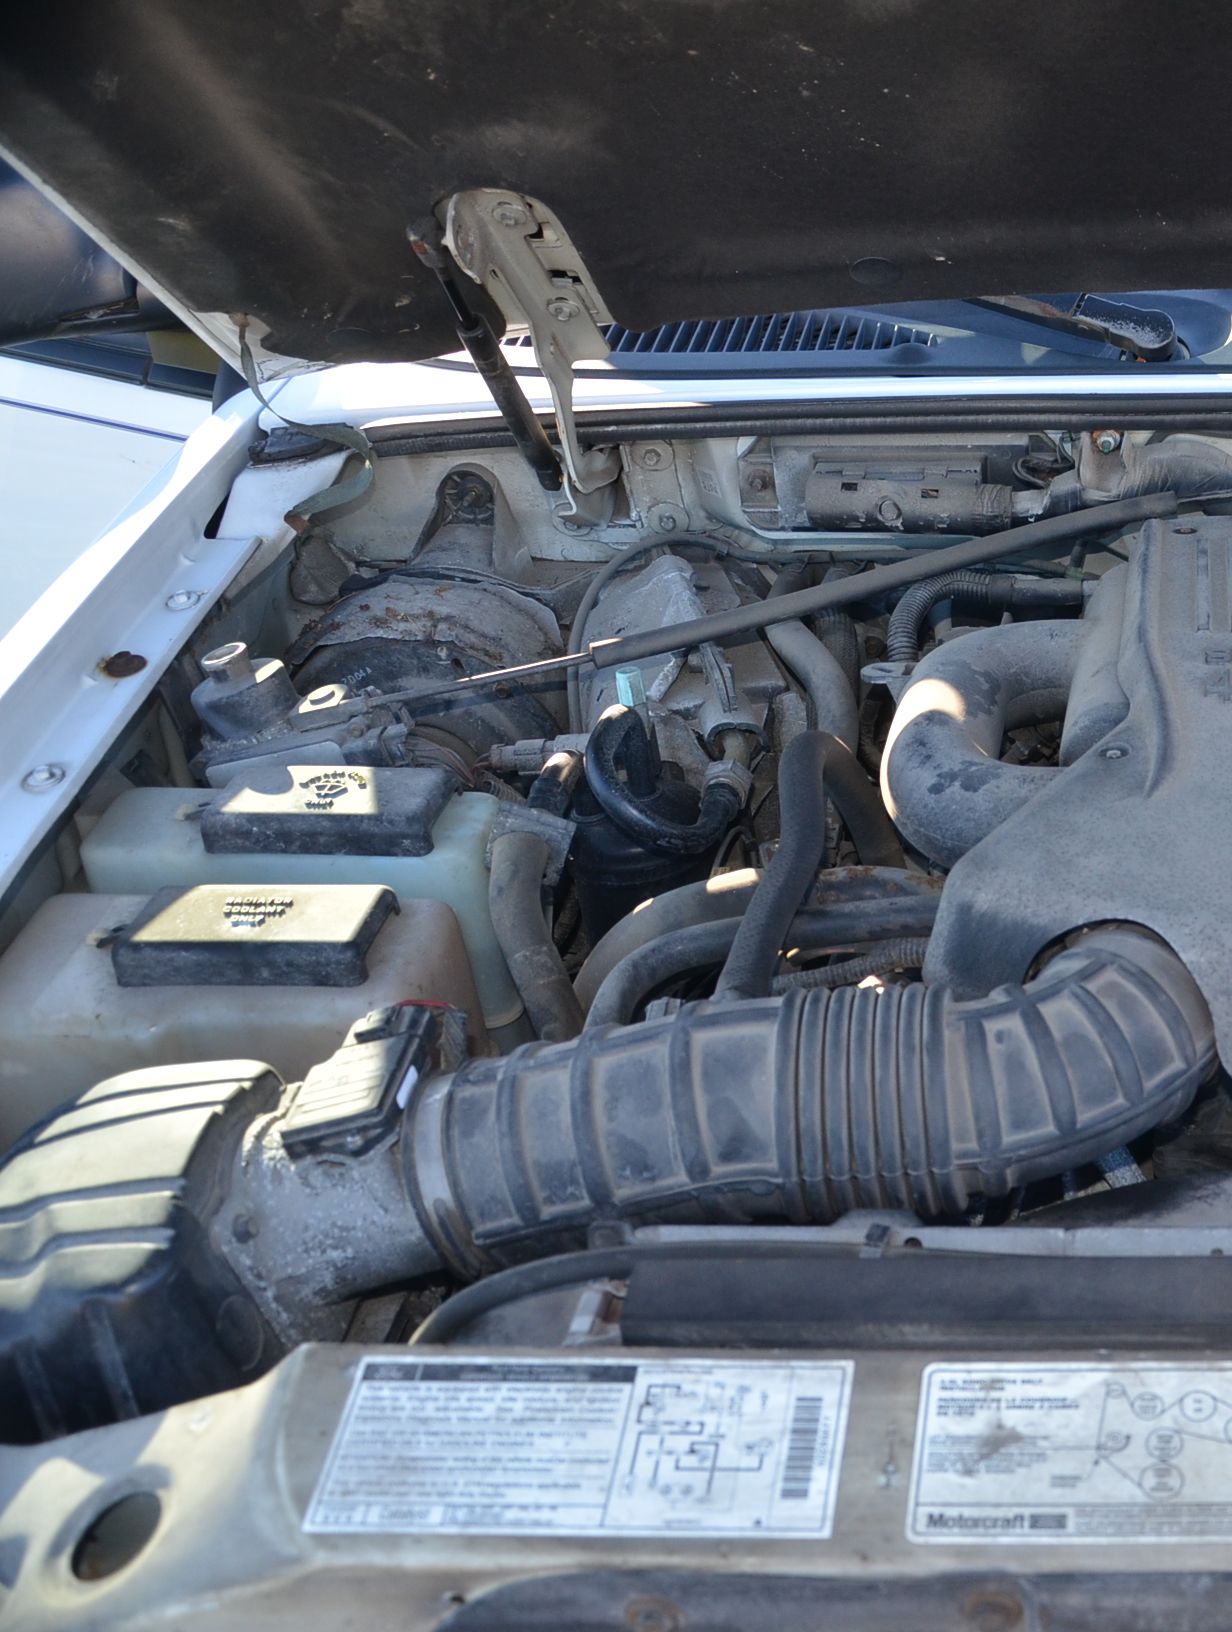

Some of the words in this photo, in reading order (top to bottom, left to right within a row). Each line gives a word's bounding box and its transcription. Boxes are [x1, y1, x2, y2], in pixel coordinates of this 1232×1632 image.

[225, 896, 293, 907] RADIATOR
[223, 905, 285, 915] COOLANT
[230, 914, 265, 924] ONLY
[926, 1513, 1025, 1530] Motorcraft
